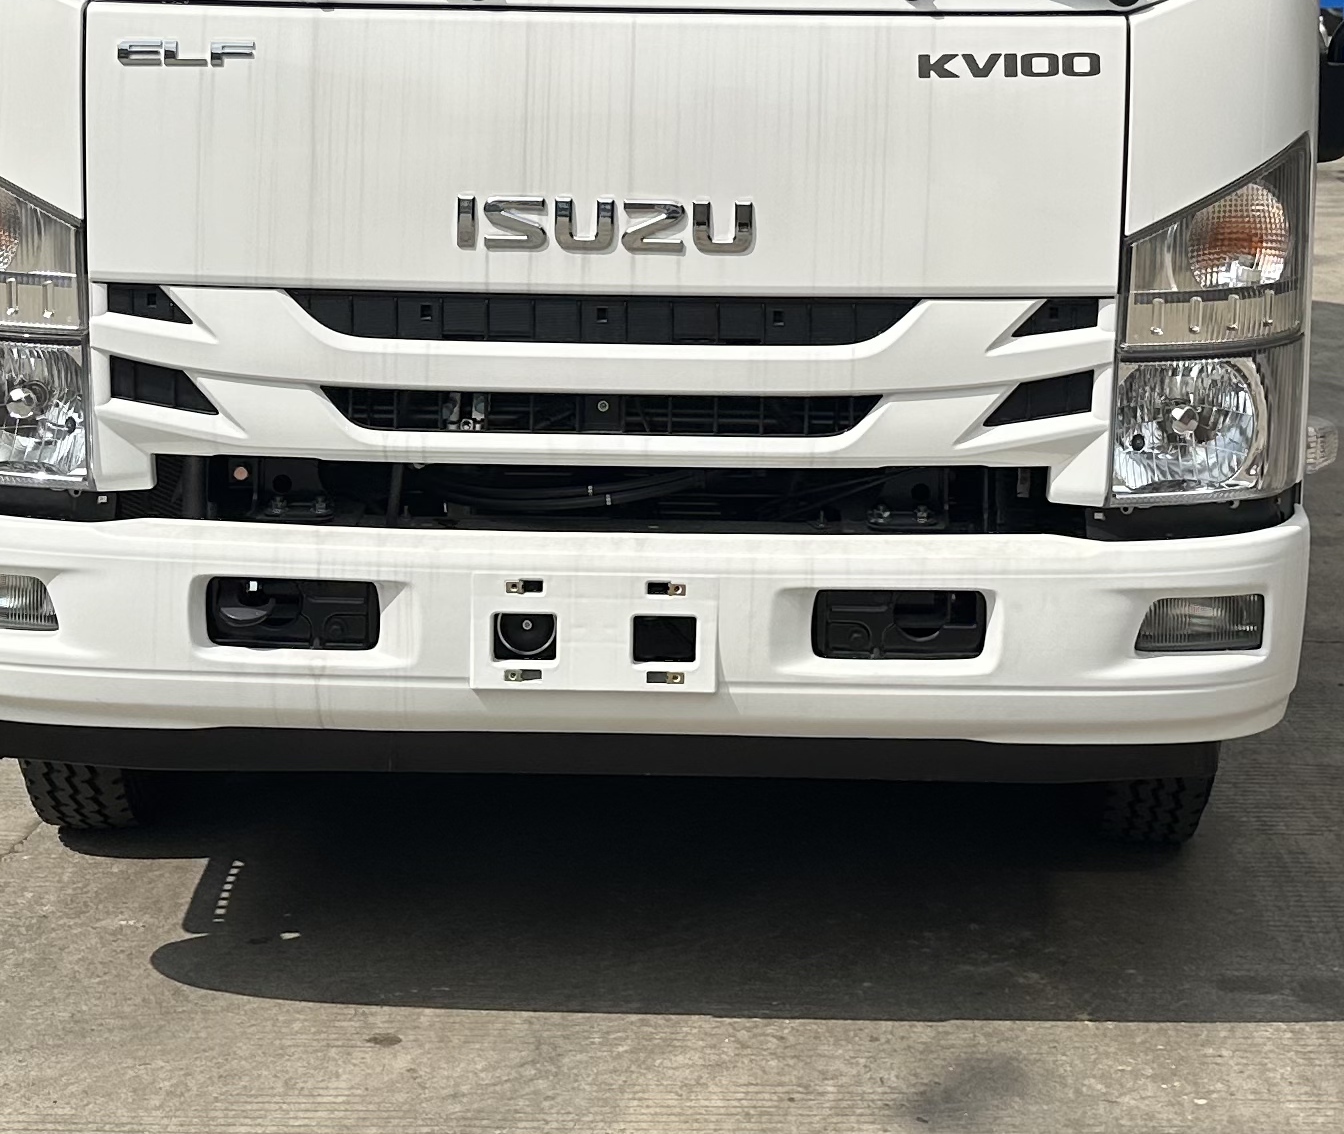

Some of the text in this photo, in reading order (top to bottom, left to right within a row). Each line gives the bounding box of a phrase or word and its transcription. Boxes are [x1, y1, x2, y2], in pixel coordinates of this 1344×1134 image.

[117, 40, 256, 68] ELF
[917, 52, 1101, 79] KV100
[456, 194, 756, 256] ISUZU
